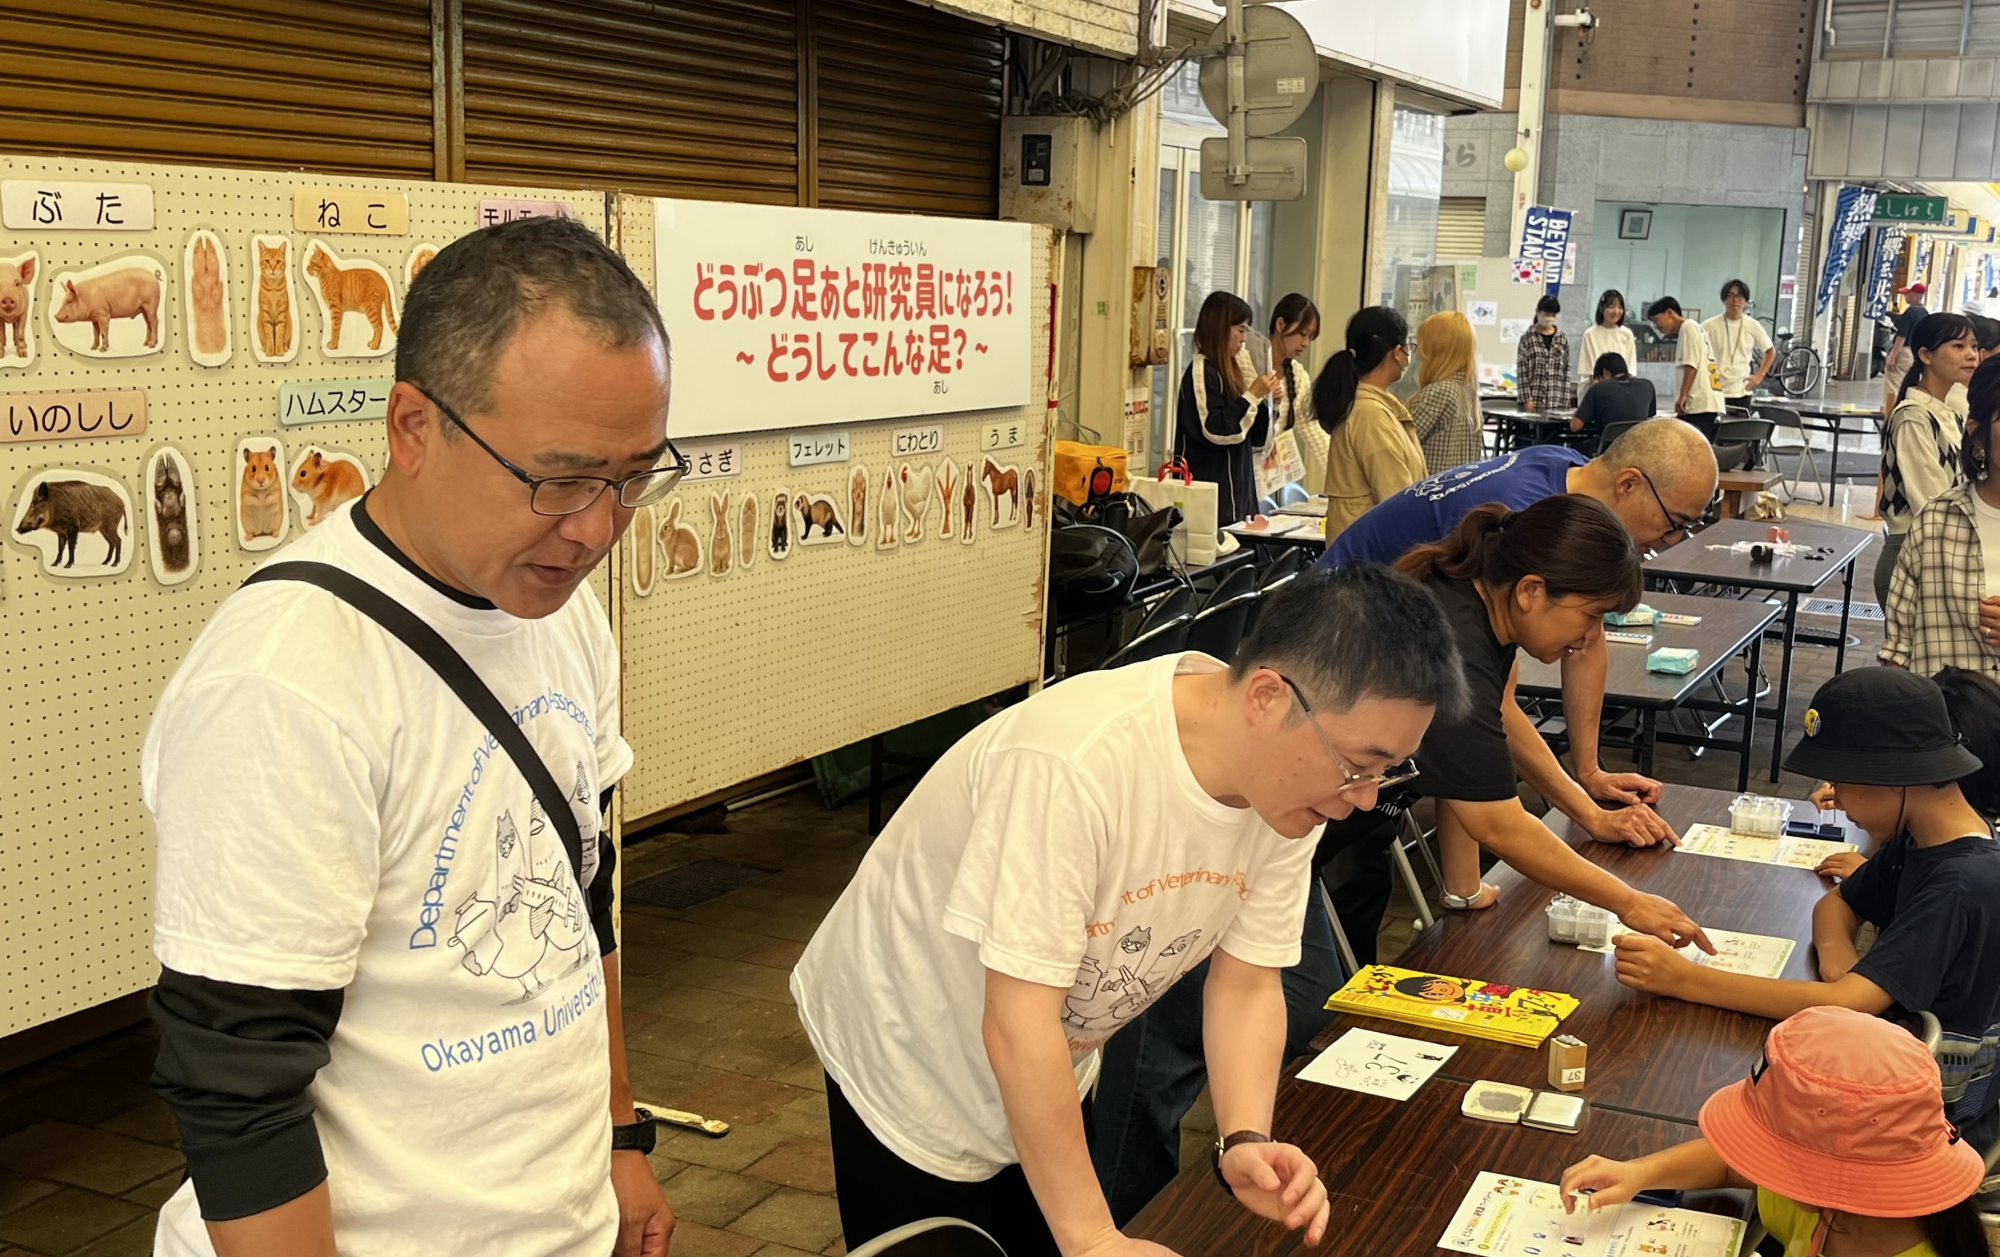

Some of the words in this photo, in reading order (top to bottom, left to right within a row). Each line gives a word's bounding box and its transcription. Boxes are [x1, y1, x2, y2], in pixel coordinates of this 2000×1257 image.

[32, 191, 125, 225] ぶた
[318, 199, 388, 229] ねこ
[794, 235, 814, 252] あし
[869, 238, 927, 257] けんきゅういん
[1542, 218, 1568, 284] BEYOND
[694, 258, 1013, 322] どうぶつ足あと研究員になろう！
[286, 386, 387, 416] ハムスター
[932, 380, 949, 395] あし
[9, 401, 134, 434] いのしし
[896, 430, 939, 453] にわとり
[990, 425, 1018, 443] うま
[682, 449, 733, 477] うさぎ
[793, 440, 846, 459] フェレット
[409, 782, 475, 951] Department
[1137, 880, 1158, 900] of
[1156, 867, 1232, 893] Veterinary
[420, 1018, 536, 1073] Okayama
[1365, 1053, 1408, 1075] 37
[1567, 1070, 1581, 1081] 37
